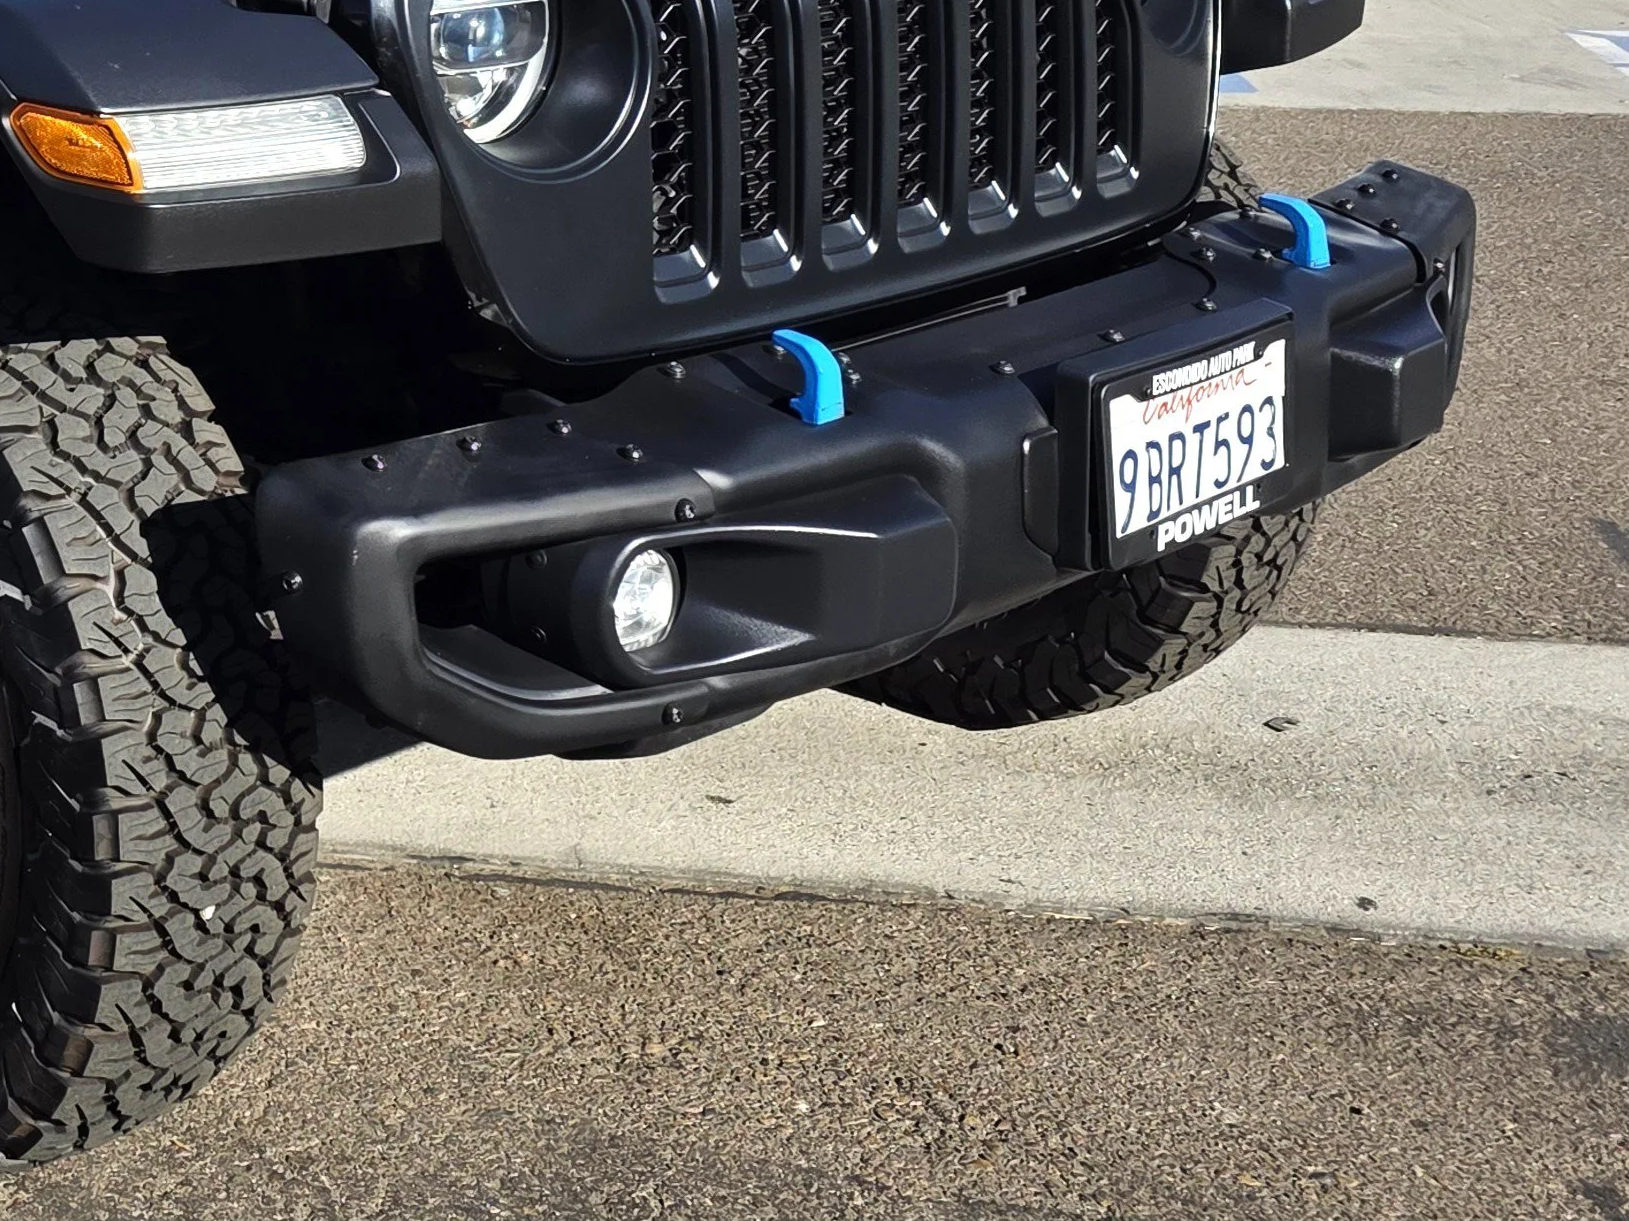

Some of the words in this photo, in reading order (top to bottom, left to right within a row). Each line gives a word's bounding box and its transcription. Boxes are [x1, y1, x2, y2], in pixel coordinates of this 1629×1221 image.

[1142, 368, 1258, 425] California
[1152, 359, 1208, 396] ESCONDIDO
[1208, 350, 1232, 377] AUTO
[1232, 341, 1256, 368] PARK
[1119, 395, 1277, 535] 9BRT593
[1157, 485, 1261, 552] POWELL
